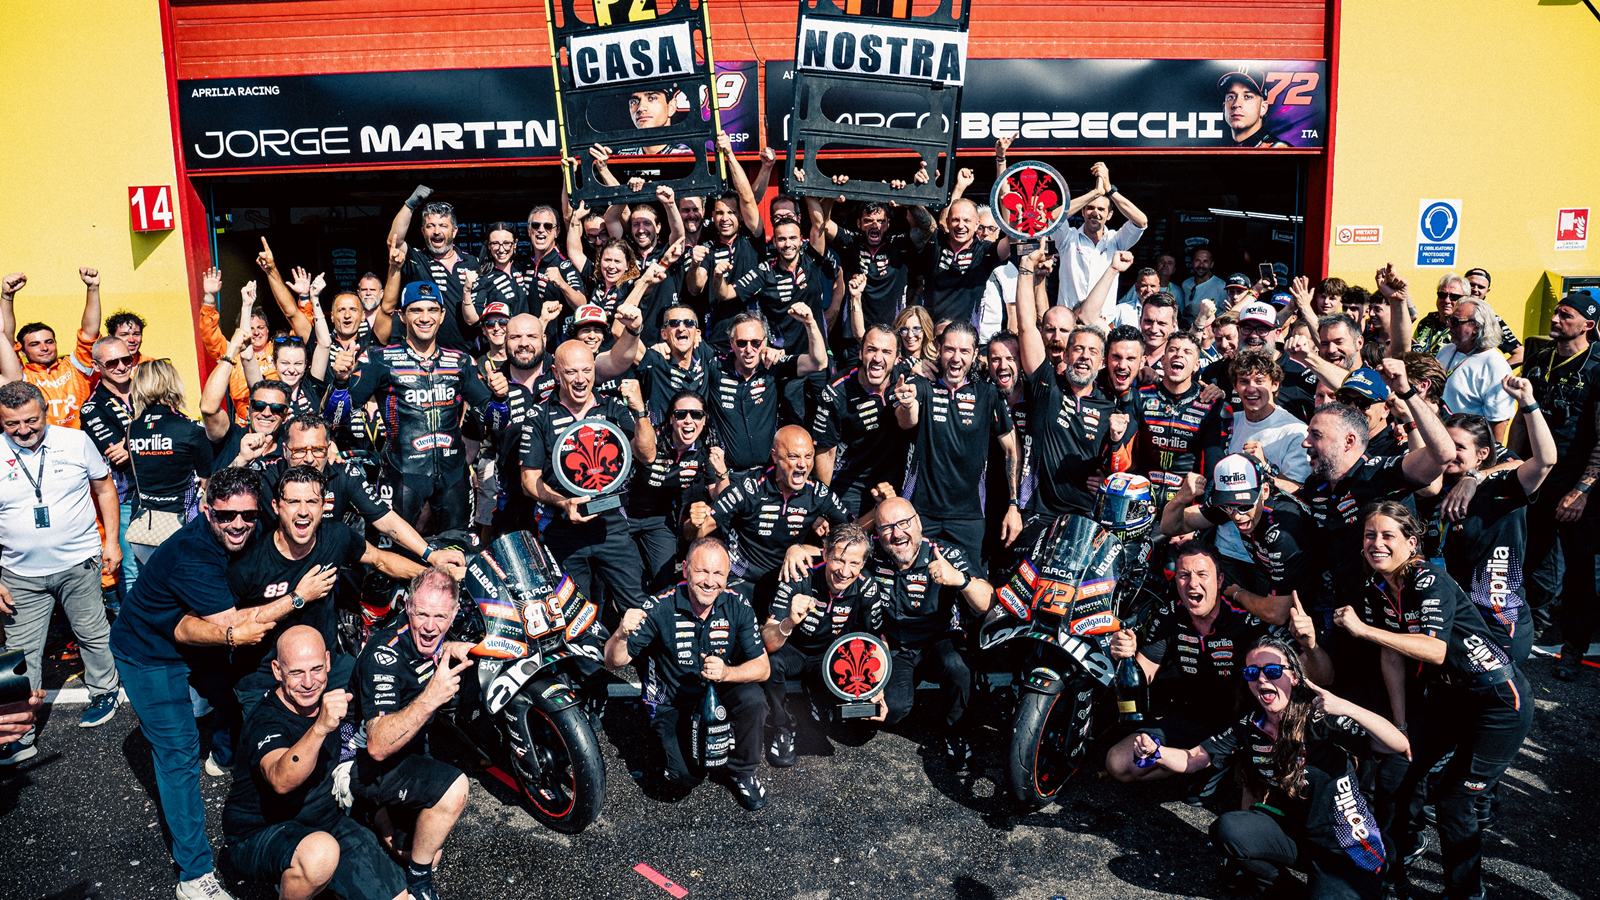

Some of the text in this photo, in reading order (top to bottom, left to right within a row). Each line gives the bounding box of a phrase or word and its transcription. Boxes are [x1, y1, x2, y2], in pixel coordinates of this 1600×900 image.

[576, 36, 682, 84] CASA
[803, 29, 961, 81] NOSTRA
[191, 85, 280, 98] APRILIA RACING
[1265, 72, 1320, 105] 72
[961, 112, 1223, 139] BEZZECCHI
[1301, 129, 1319, 139] ITA
[194, 119, 556, 159] JORGE MARTIN
[729, 133, 749, 143] ESP
[131, 187, 172, 229] 14
[581, 305, 602, 317] 72
[405, 384, 455, 405] aprilia
[1174, 429, 1193, 437] TARGA
[130, 434, 173, 454] aprilia
[1151, 435, 1187, 449] aprilia
[1219, 472, 1246, 484] aprilia
[906, 574, 928, 582] aprilia
[1041, 566, 1073, 580] TARGA
[1486, 546, 1512, 607] aprilia
[263, 581, 289, 598] 89
[518, 584, 554, 601] TARGA
[1032, 578, 1076, 616] 72
[1082, 584, 1110, 595] BS
[1001, 588, 1026, 617] sterilgarda
[570, 606, 594, 635] sterilgarda
[591, 620, 602, 636] sky
[1075, 616, 1111, 633] sterilgarda
[486, 639, 523, 654] sterilgarda
[1100, 636, 1113, 647] sk
[1207, 638, 1233, 649] aprilia
[480, 661, 501, 673] sky
[1335, 775, 1369, 841] aprilia
